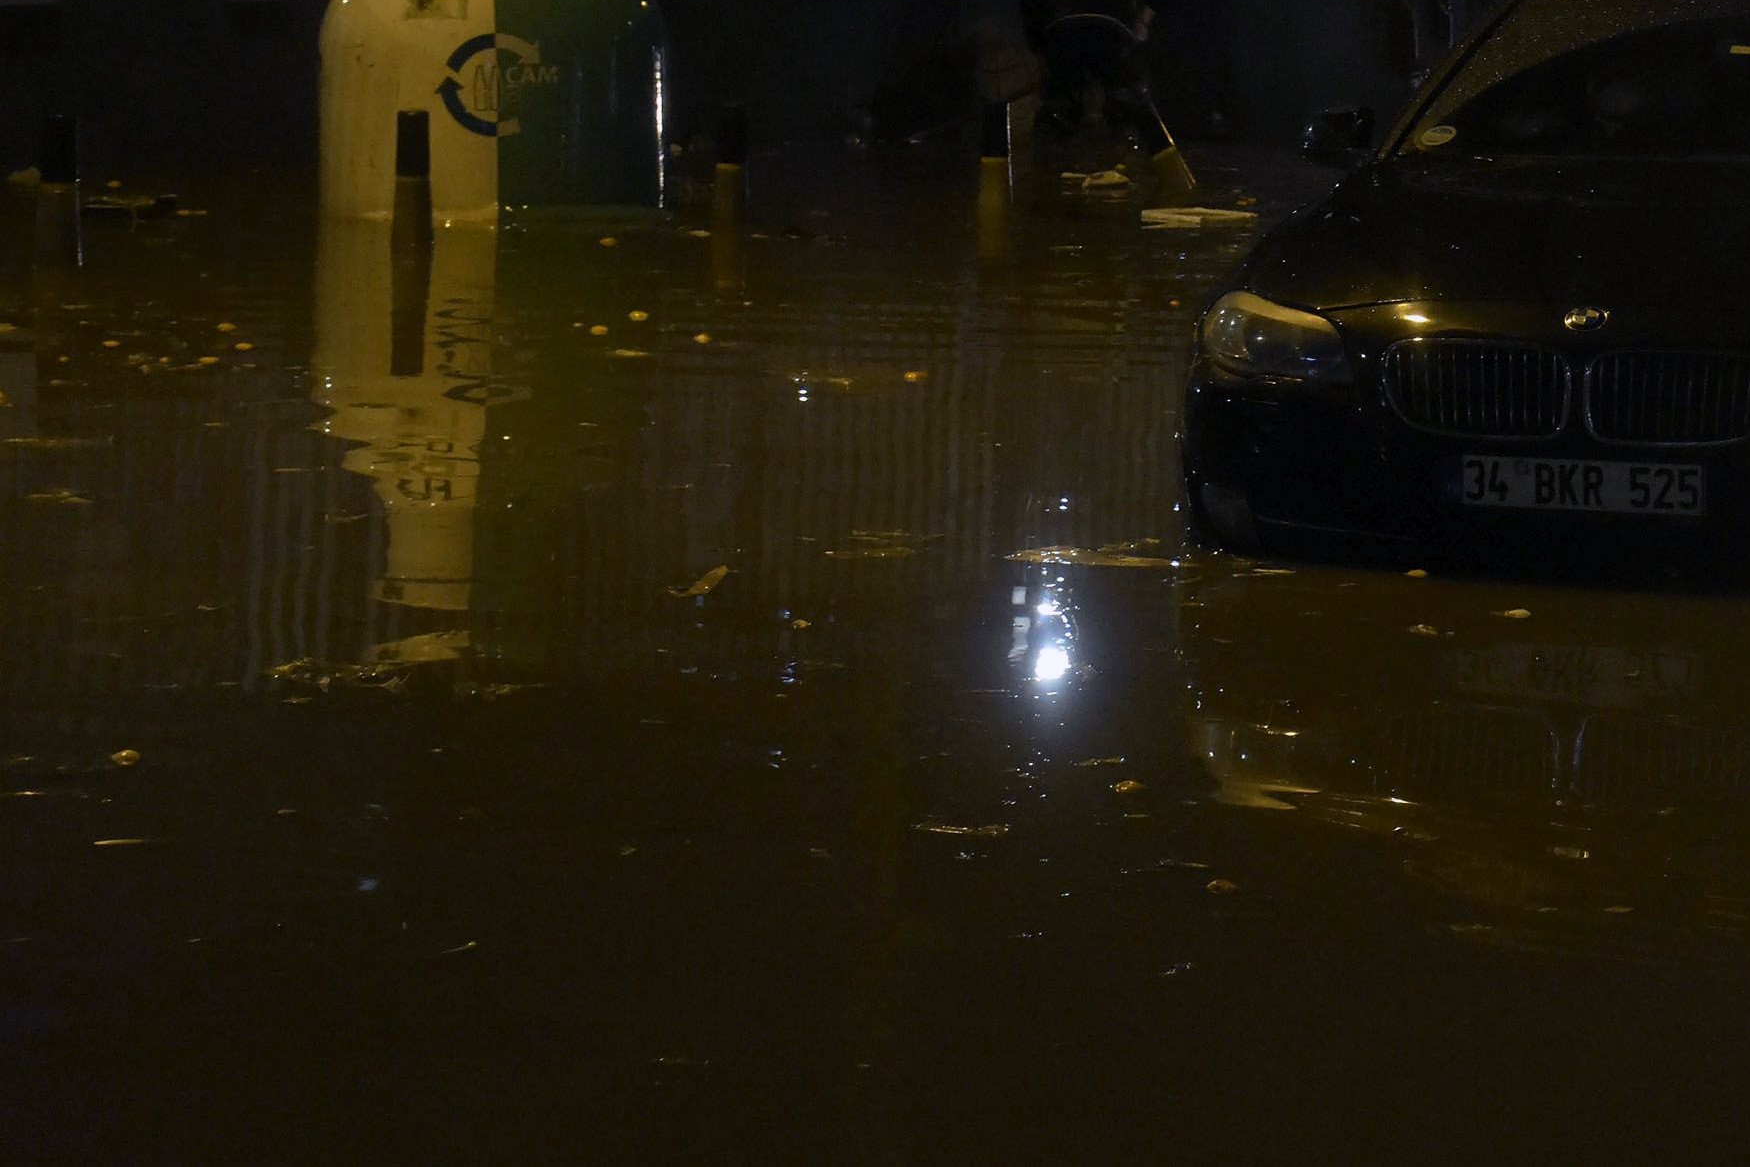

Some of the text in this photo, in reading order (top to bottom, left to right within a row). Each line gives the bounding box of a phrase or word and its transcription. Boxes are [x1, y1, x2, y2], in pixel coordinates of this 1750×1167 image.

[1465, 460, 1698, 509] 34 BKR 525
